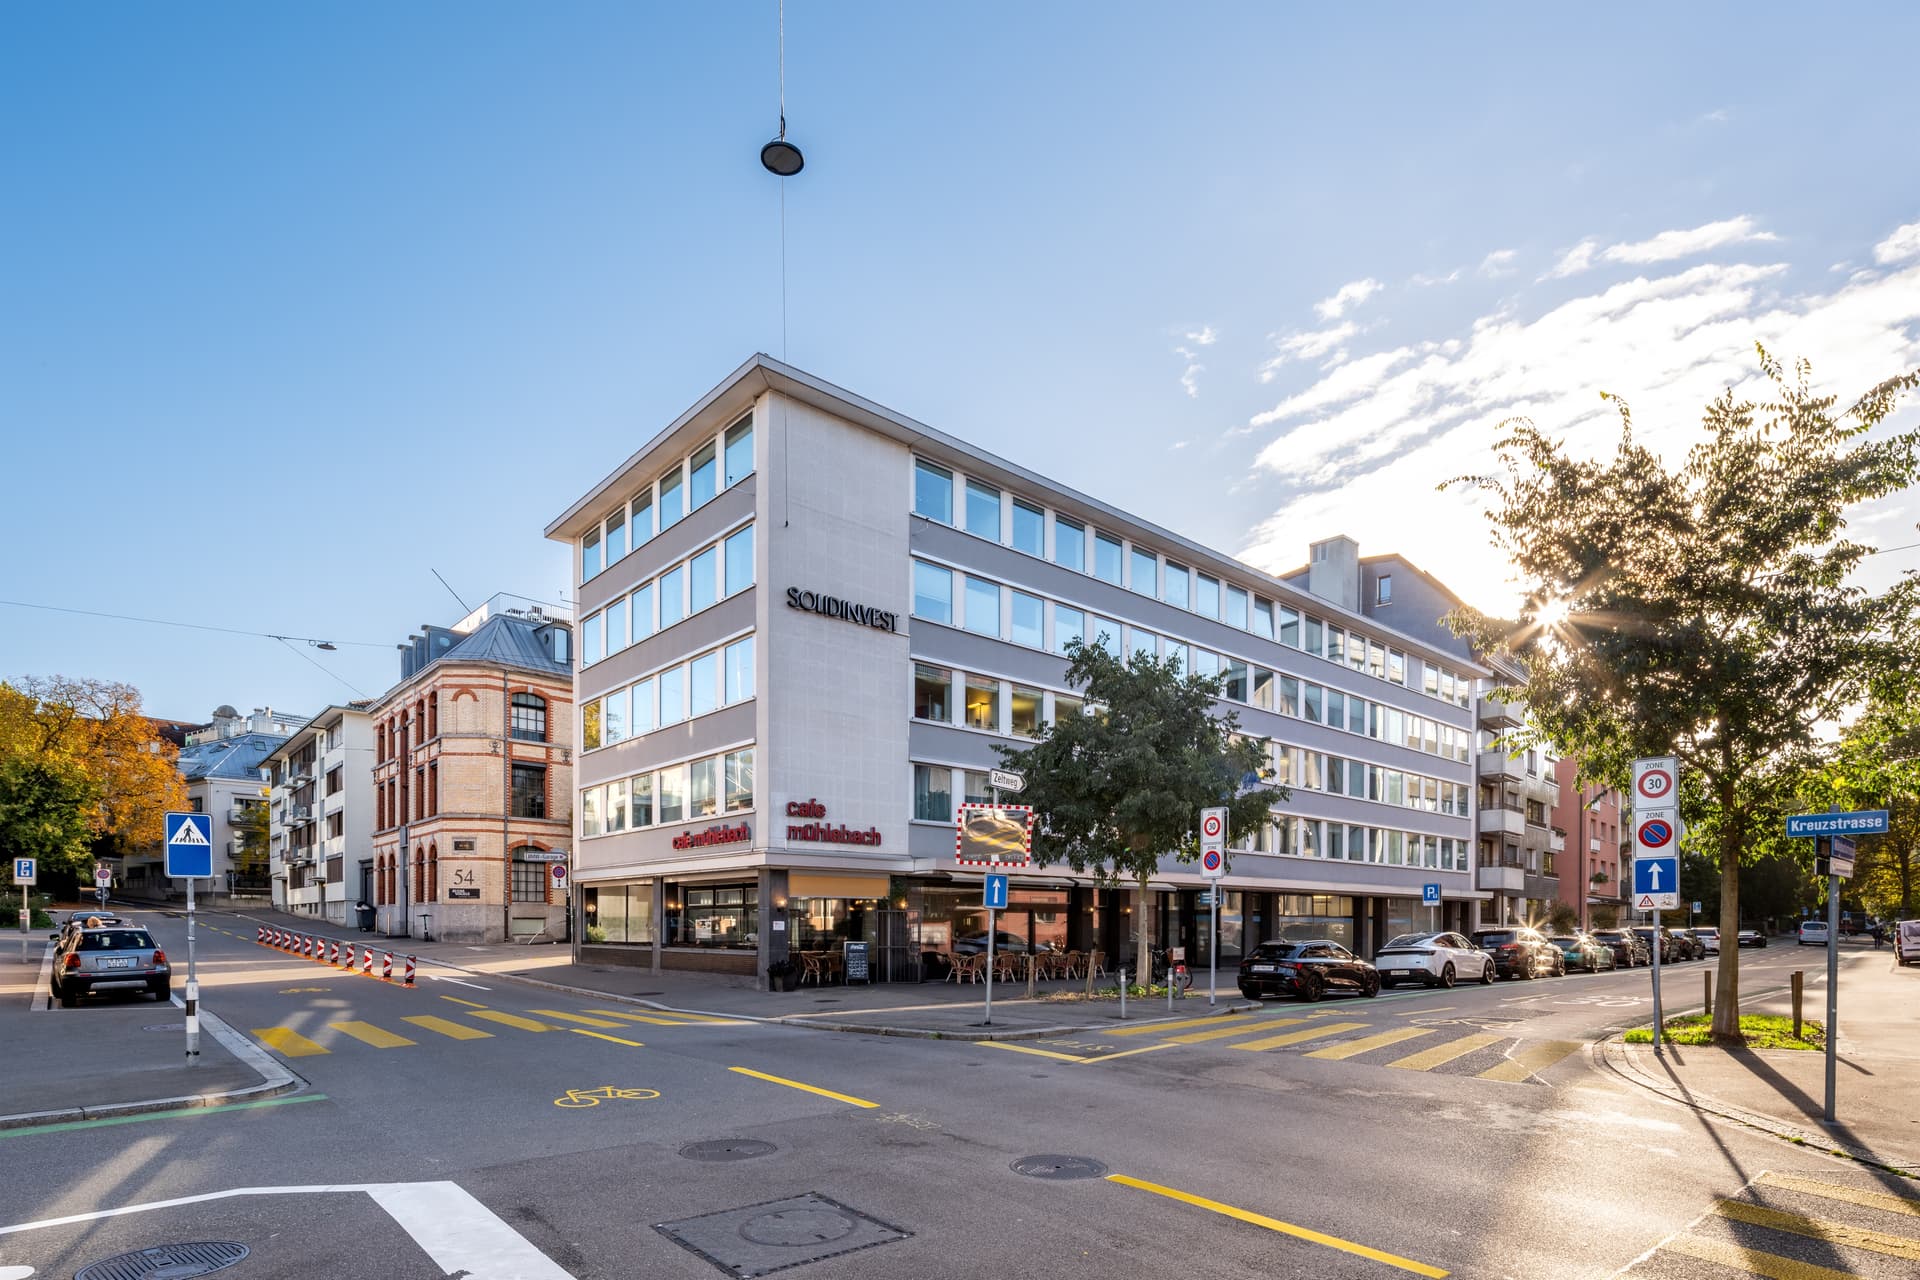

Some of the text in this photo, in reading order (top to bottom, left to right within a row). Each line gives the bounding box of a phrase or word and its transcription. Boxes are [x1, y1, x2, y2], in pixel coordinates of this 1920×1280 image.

[786, 586, 899, 632] SOLIDINVEST
[994, 772, 1018, 790] Zeltweg
[1648, 778, 1662, 790] 30
[1208, 822, 1216, 830] 30
[1791, 817, 1883, 832] Kreuzstrasse
[787, 822, 882, 846] mühlebach
[453, 869, 474, 886] 54
[1427, 887, 1434, 898] P
